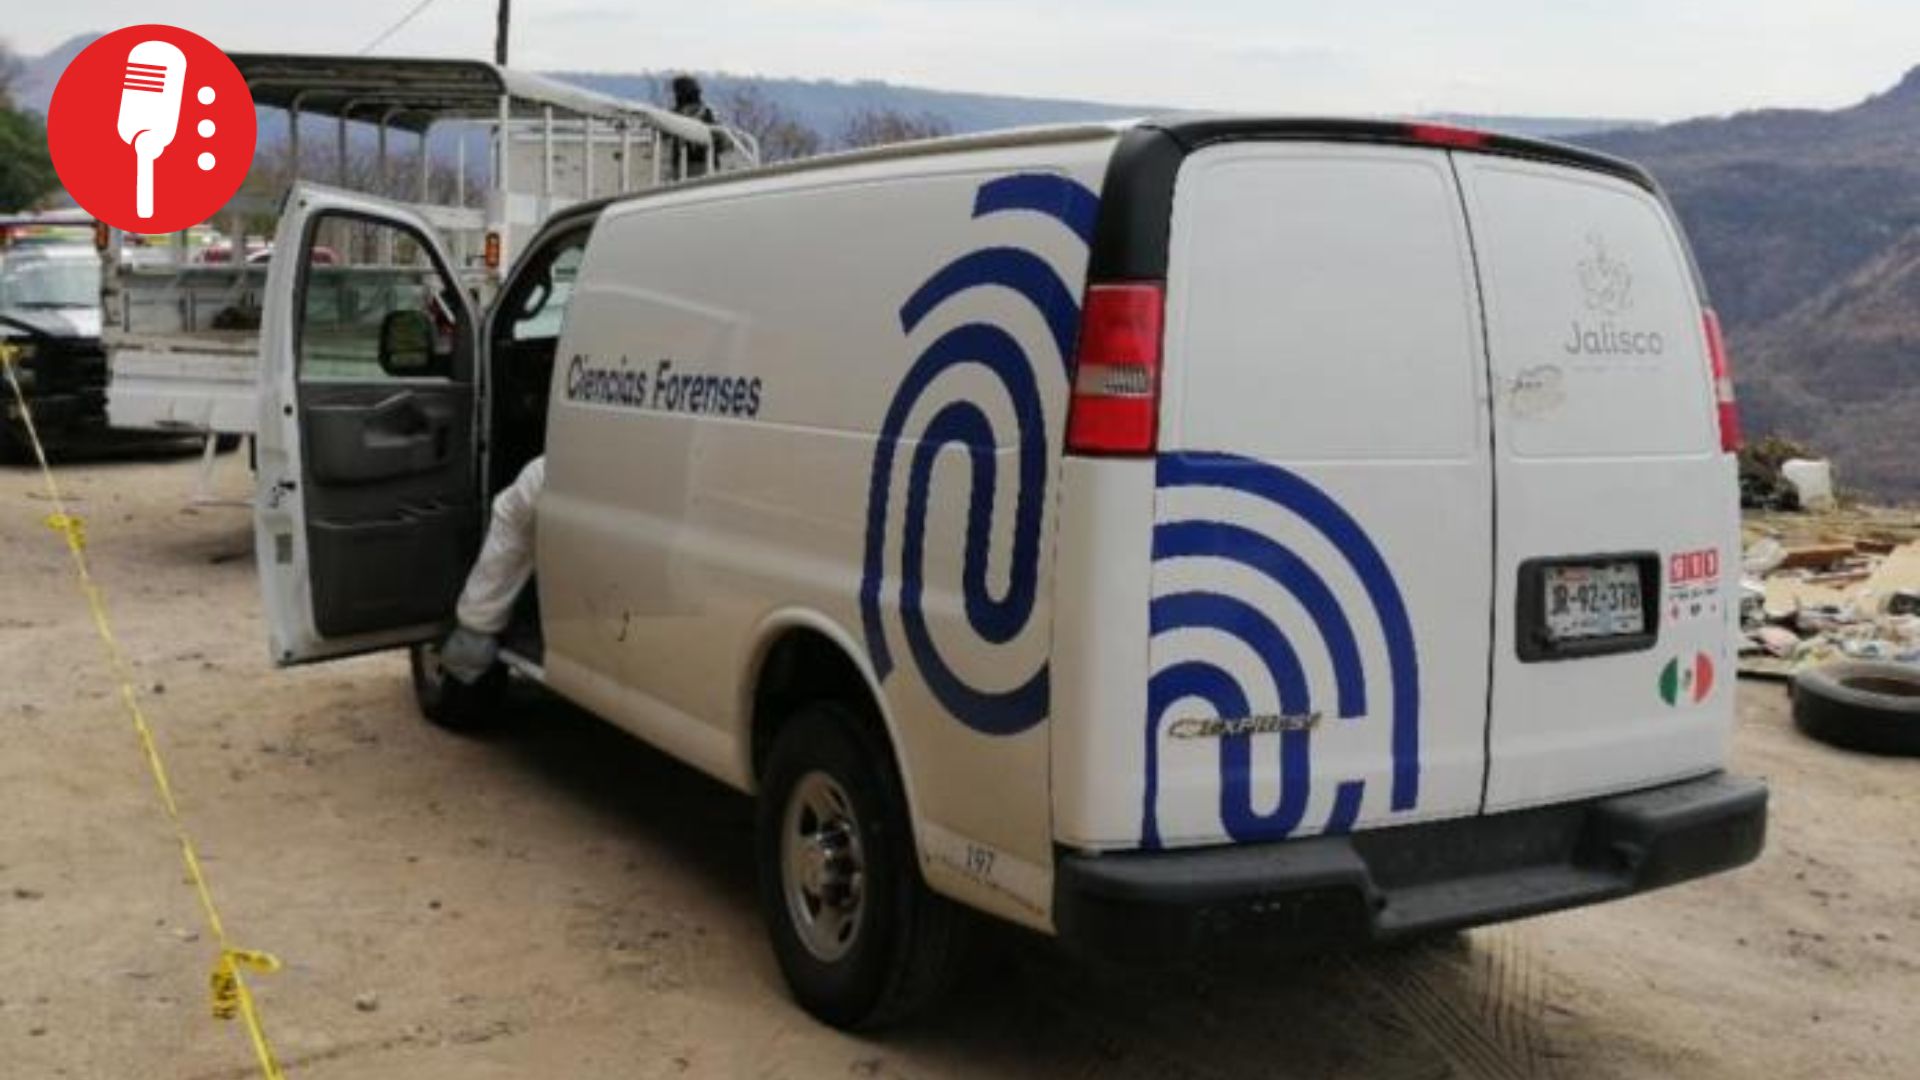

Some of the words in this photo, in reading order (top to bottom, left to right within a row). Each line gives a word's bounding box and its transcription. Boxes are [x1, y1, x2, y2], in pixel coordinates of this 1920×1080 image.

[1565, 321, 1664, 355] Jalisco
[568, 354, 647, 406] Ciencias
[653, 358, 763, 416] Forenses
[967, 843, 995, 874] 197
